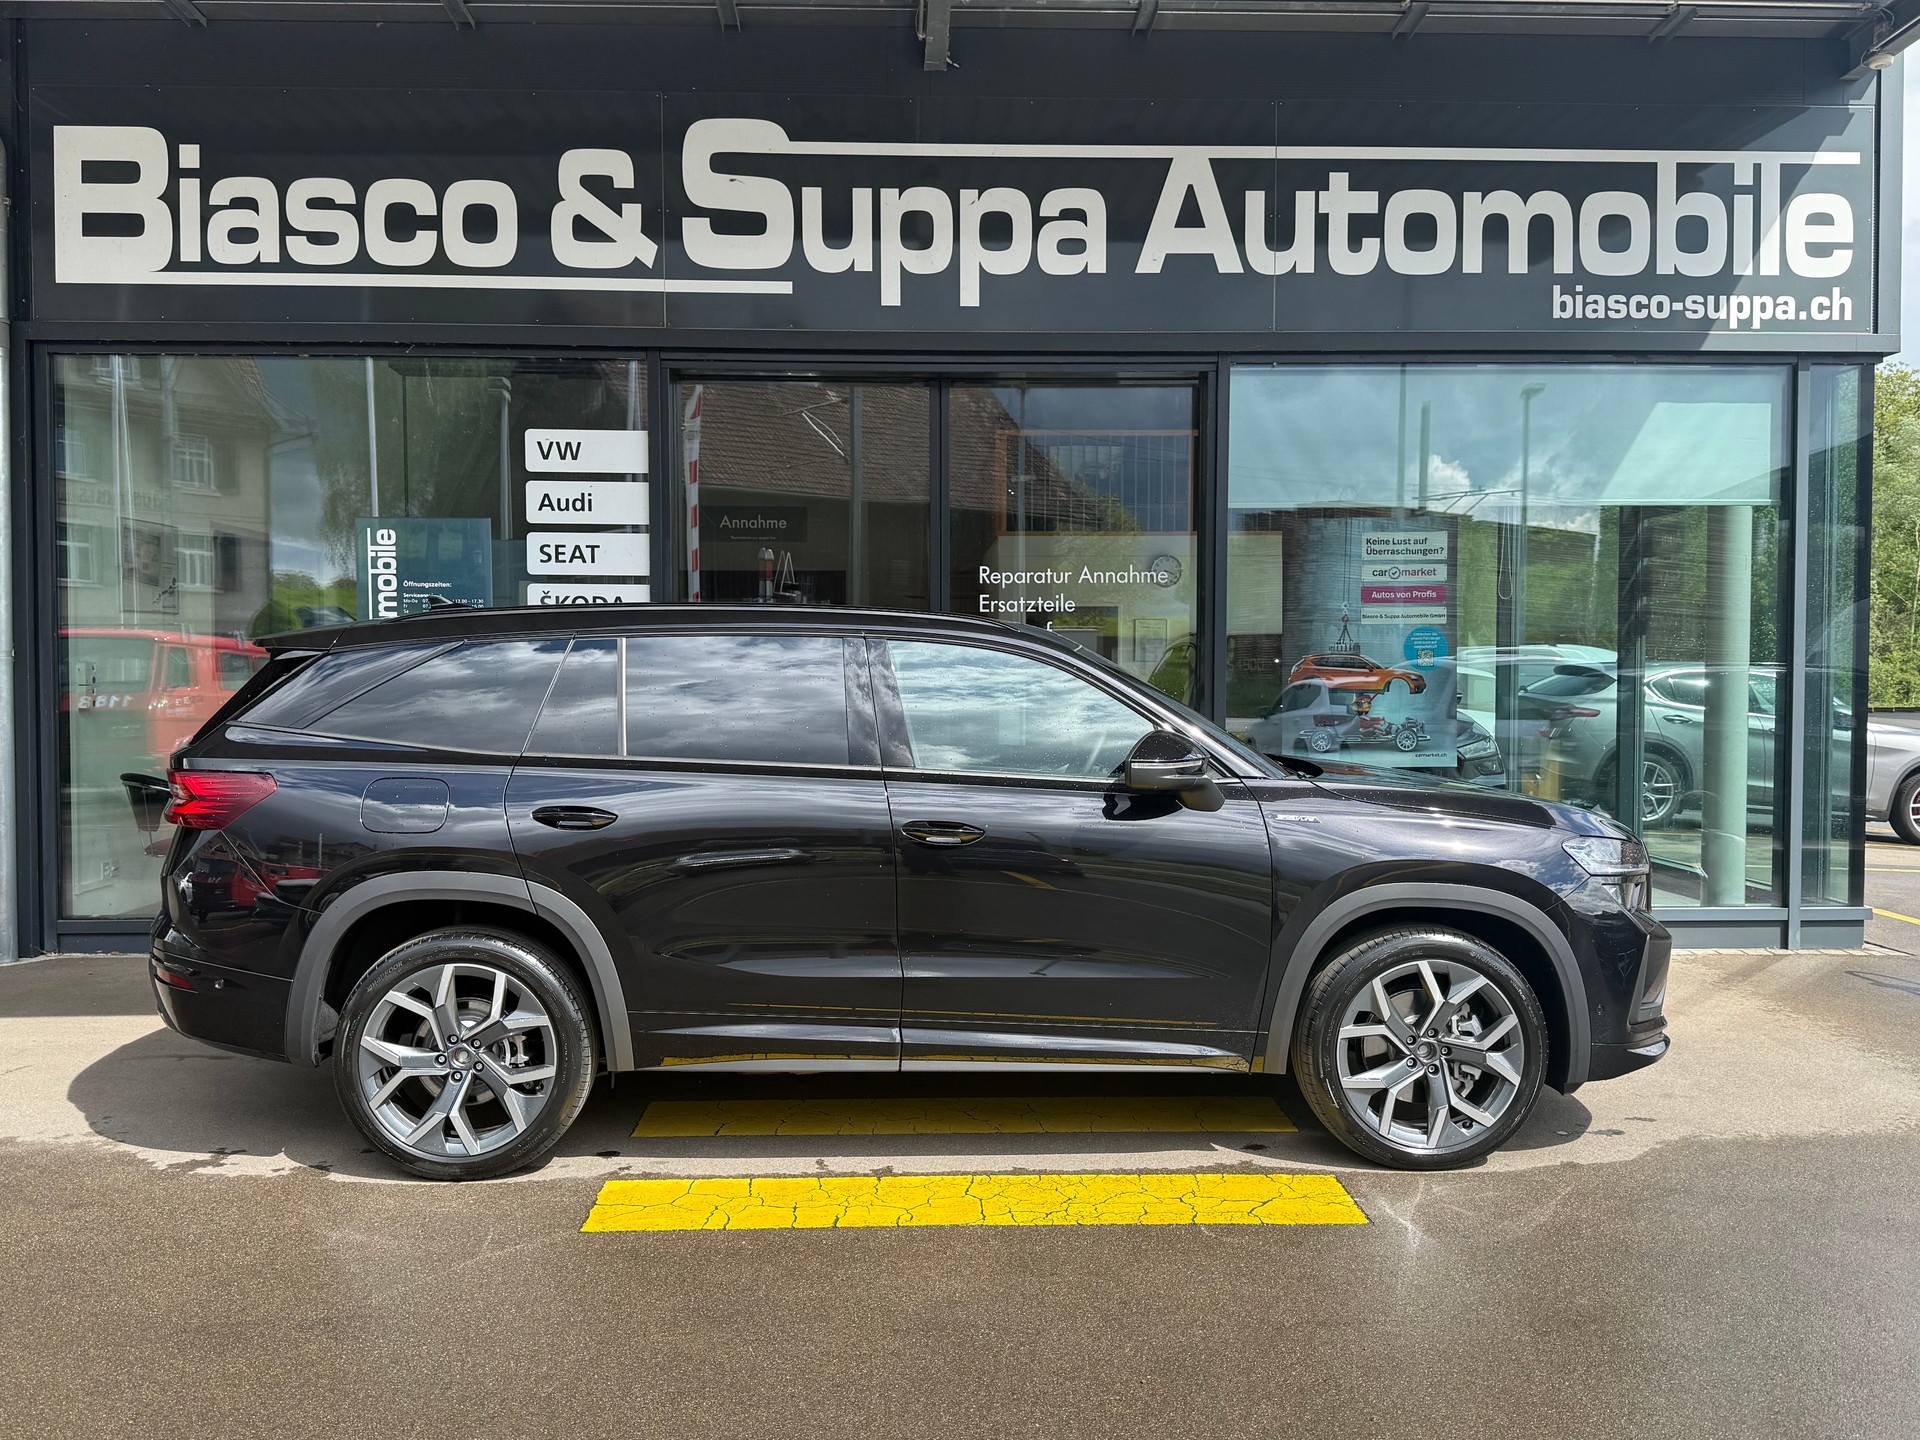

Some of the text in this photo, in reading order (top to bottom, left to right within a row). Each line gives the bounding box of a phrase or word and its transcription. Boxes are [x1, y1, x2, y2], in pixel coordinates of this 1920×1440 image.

[54, 118, 1856, 307] Biasco & Suppa Automobile
[1552, 284, 1853, 330] biasco-suppa.ch
[536, 441, 582, 461] VW
[537, 492, 593, 512] Audi
[719, 514, 787, 529] Annahme
[1366, 537, 1428, 546] Keine Lust auf
[1366, 546, 1445, 556] Überraschungen?
[539, 544, 600, 564] SEAT
[979, 565, 1169, 588] Reparatur Annahme
[979, 593, 1076, 612] Ersatzteile
[1412, 590, 1437, 598] Profis
